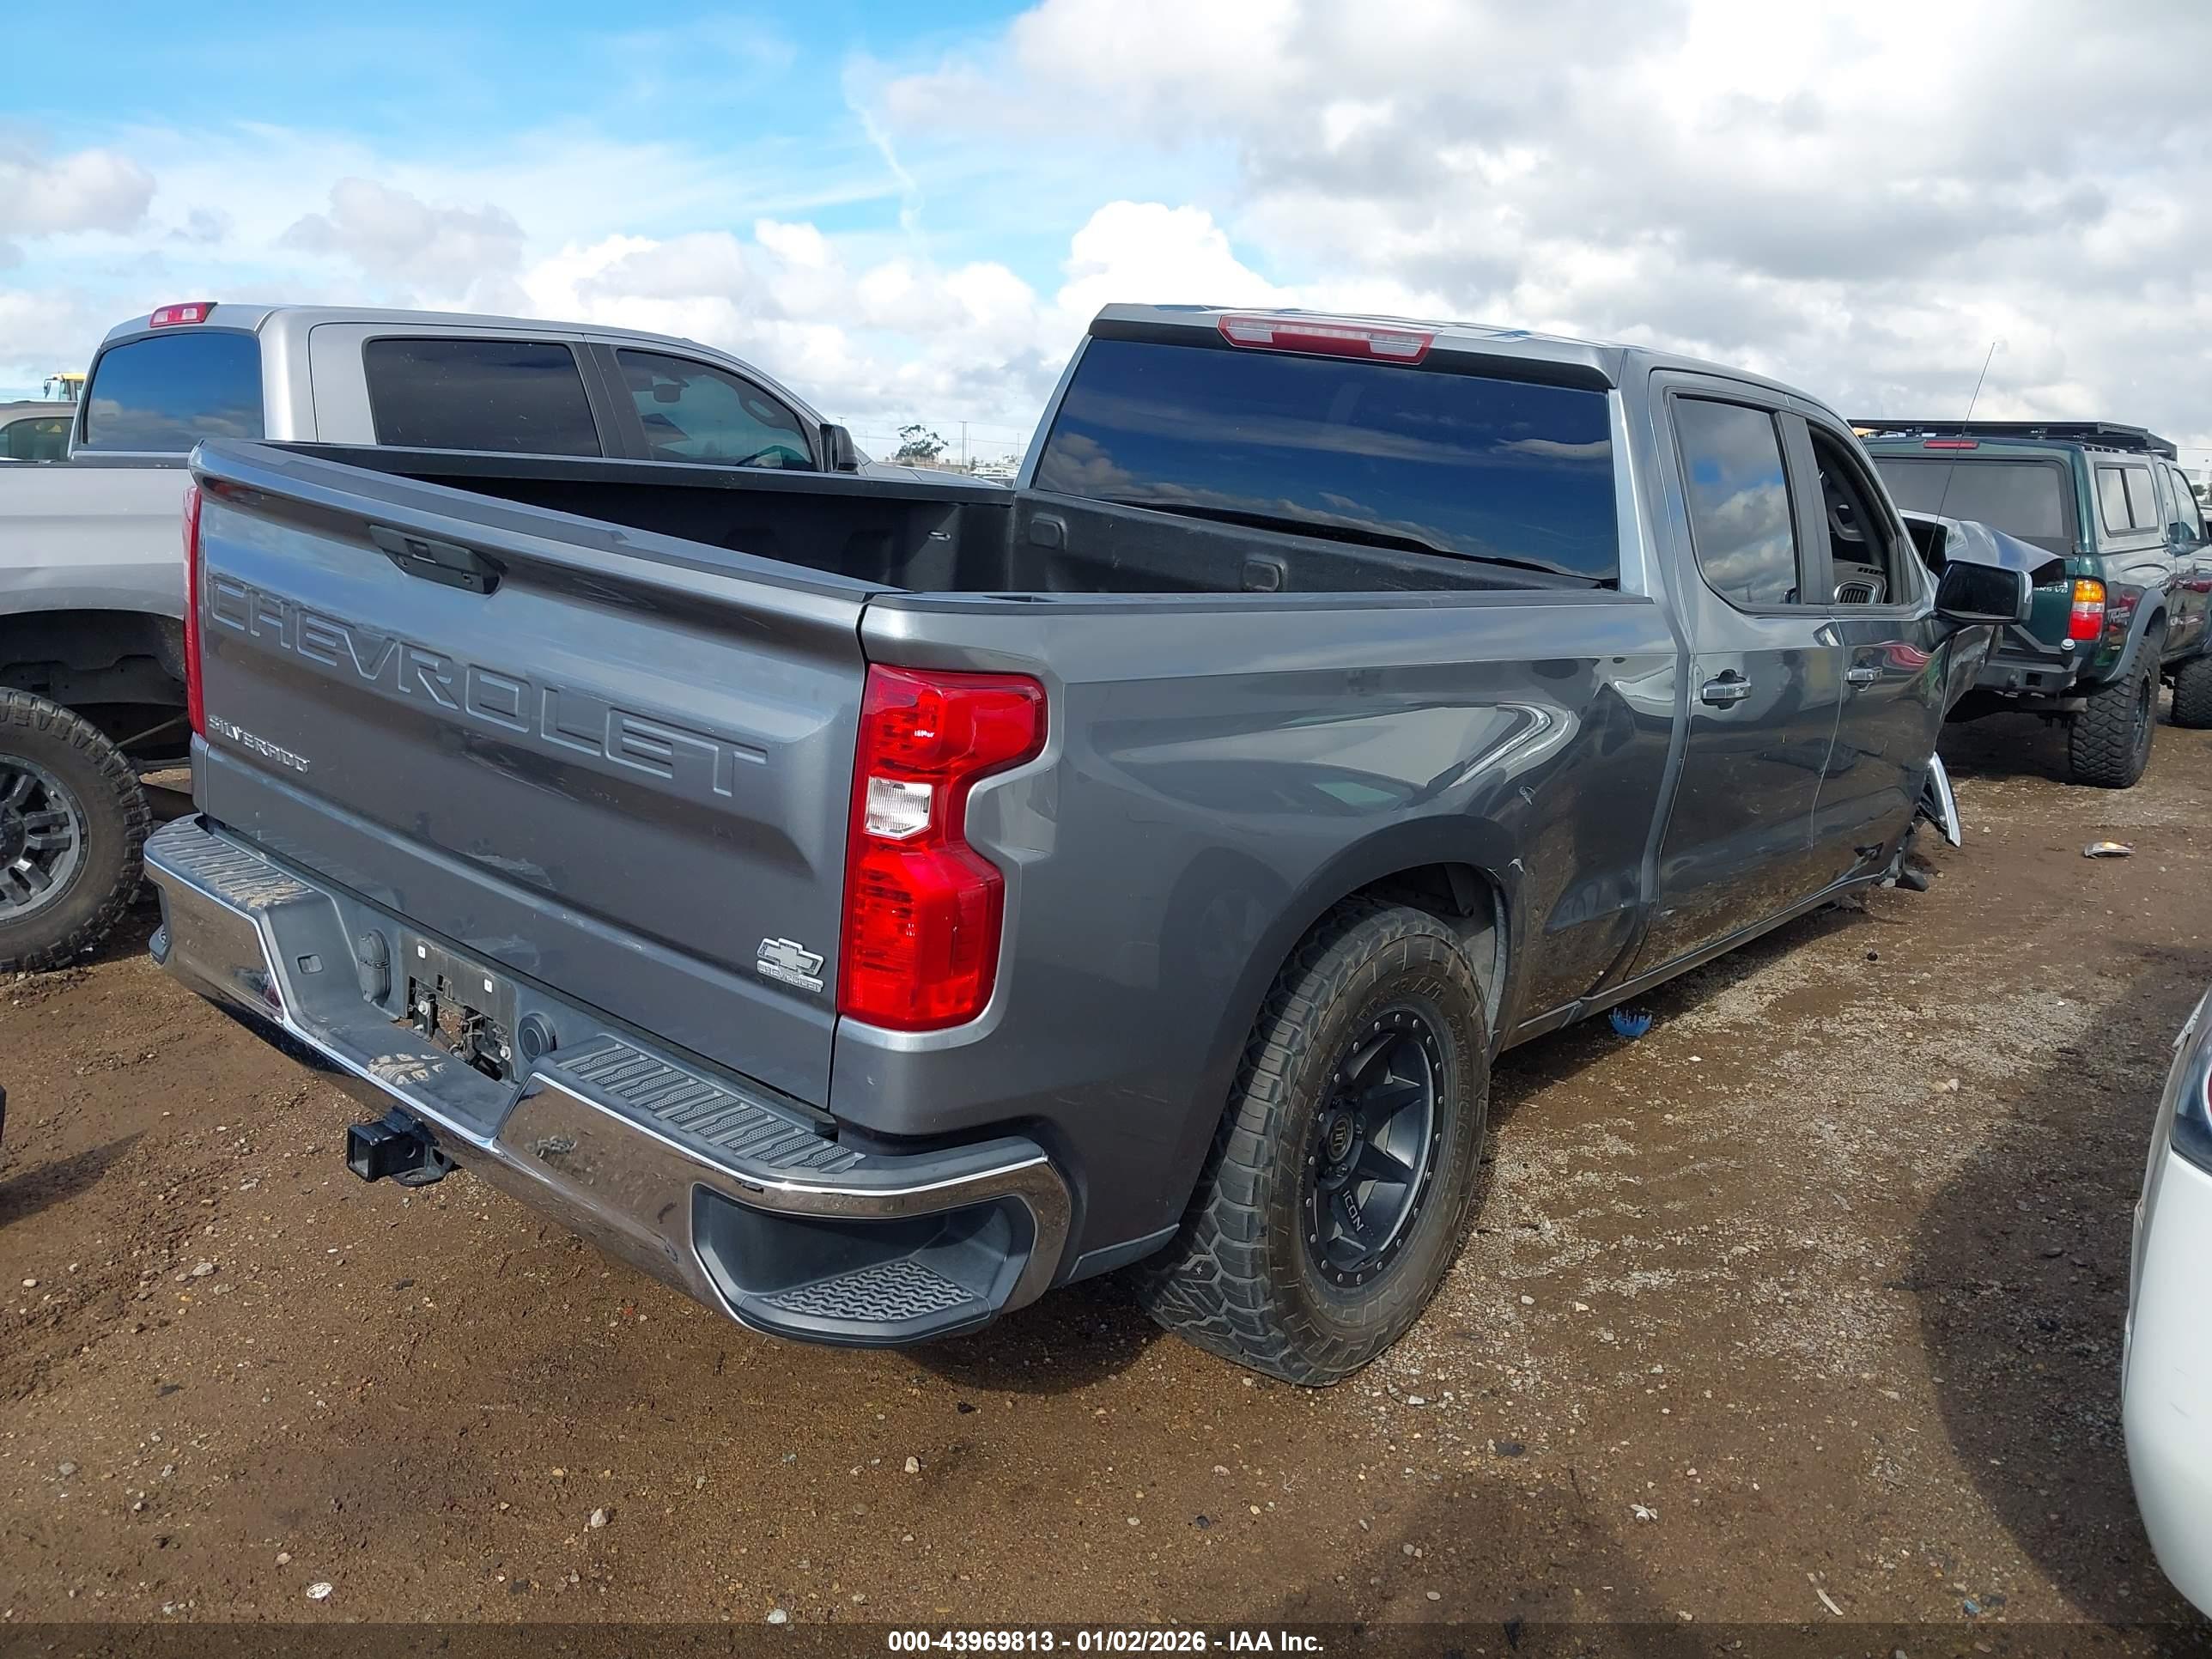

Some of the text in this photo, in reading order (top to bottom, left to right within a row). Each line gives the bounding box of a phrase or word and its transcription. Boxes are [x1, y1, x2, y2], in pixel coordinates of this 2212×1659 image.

[205, 572, 769, 798] CHEVROLET
[208, 714, 311, 775] SILVERADO
[1342, 1189, 1364, 1232] ICON
